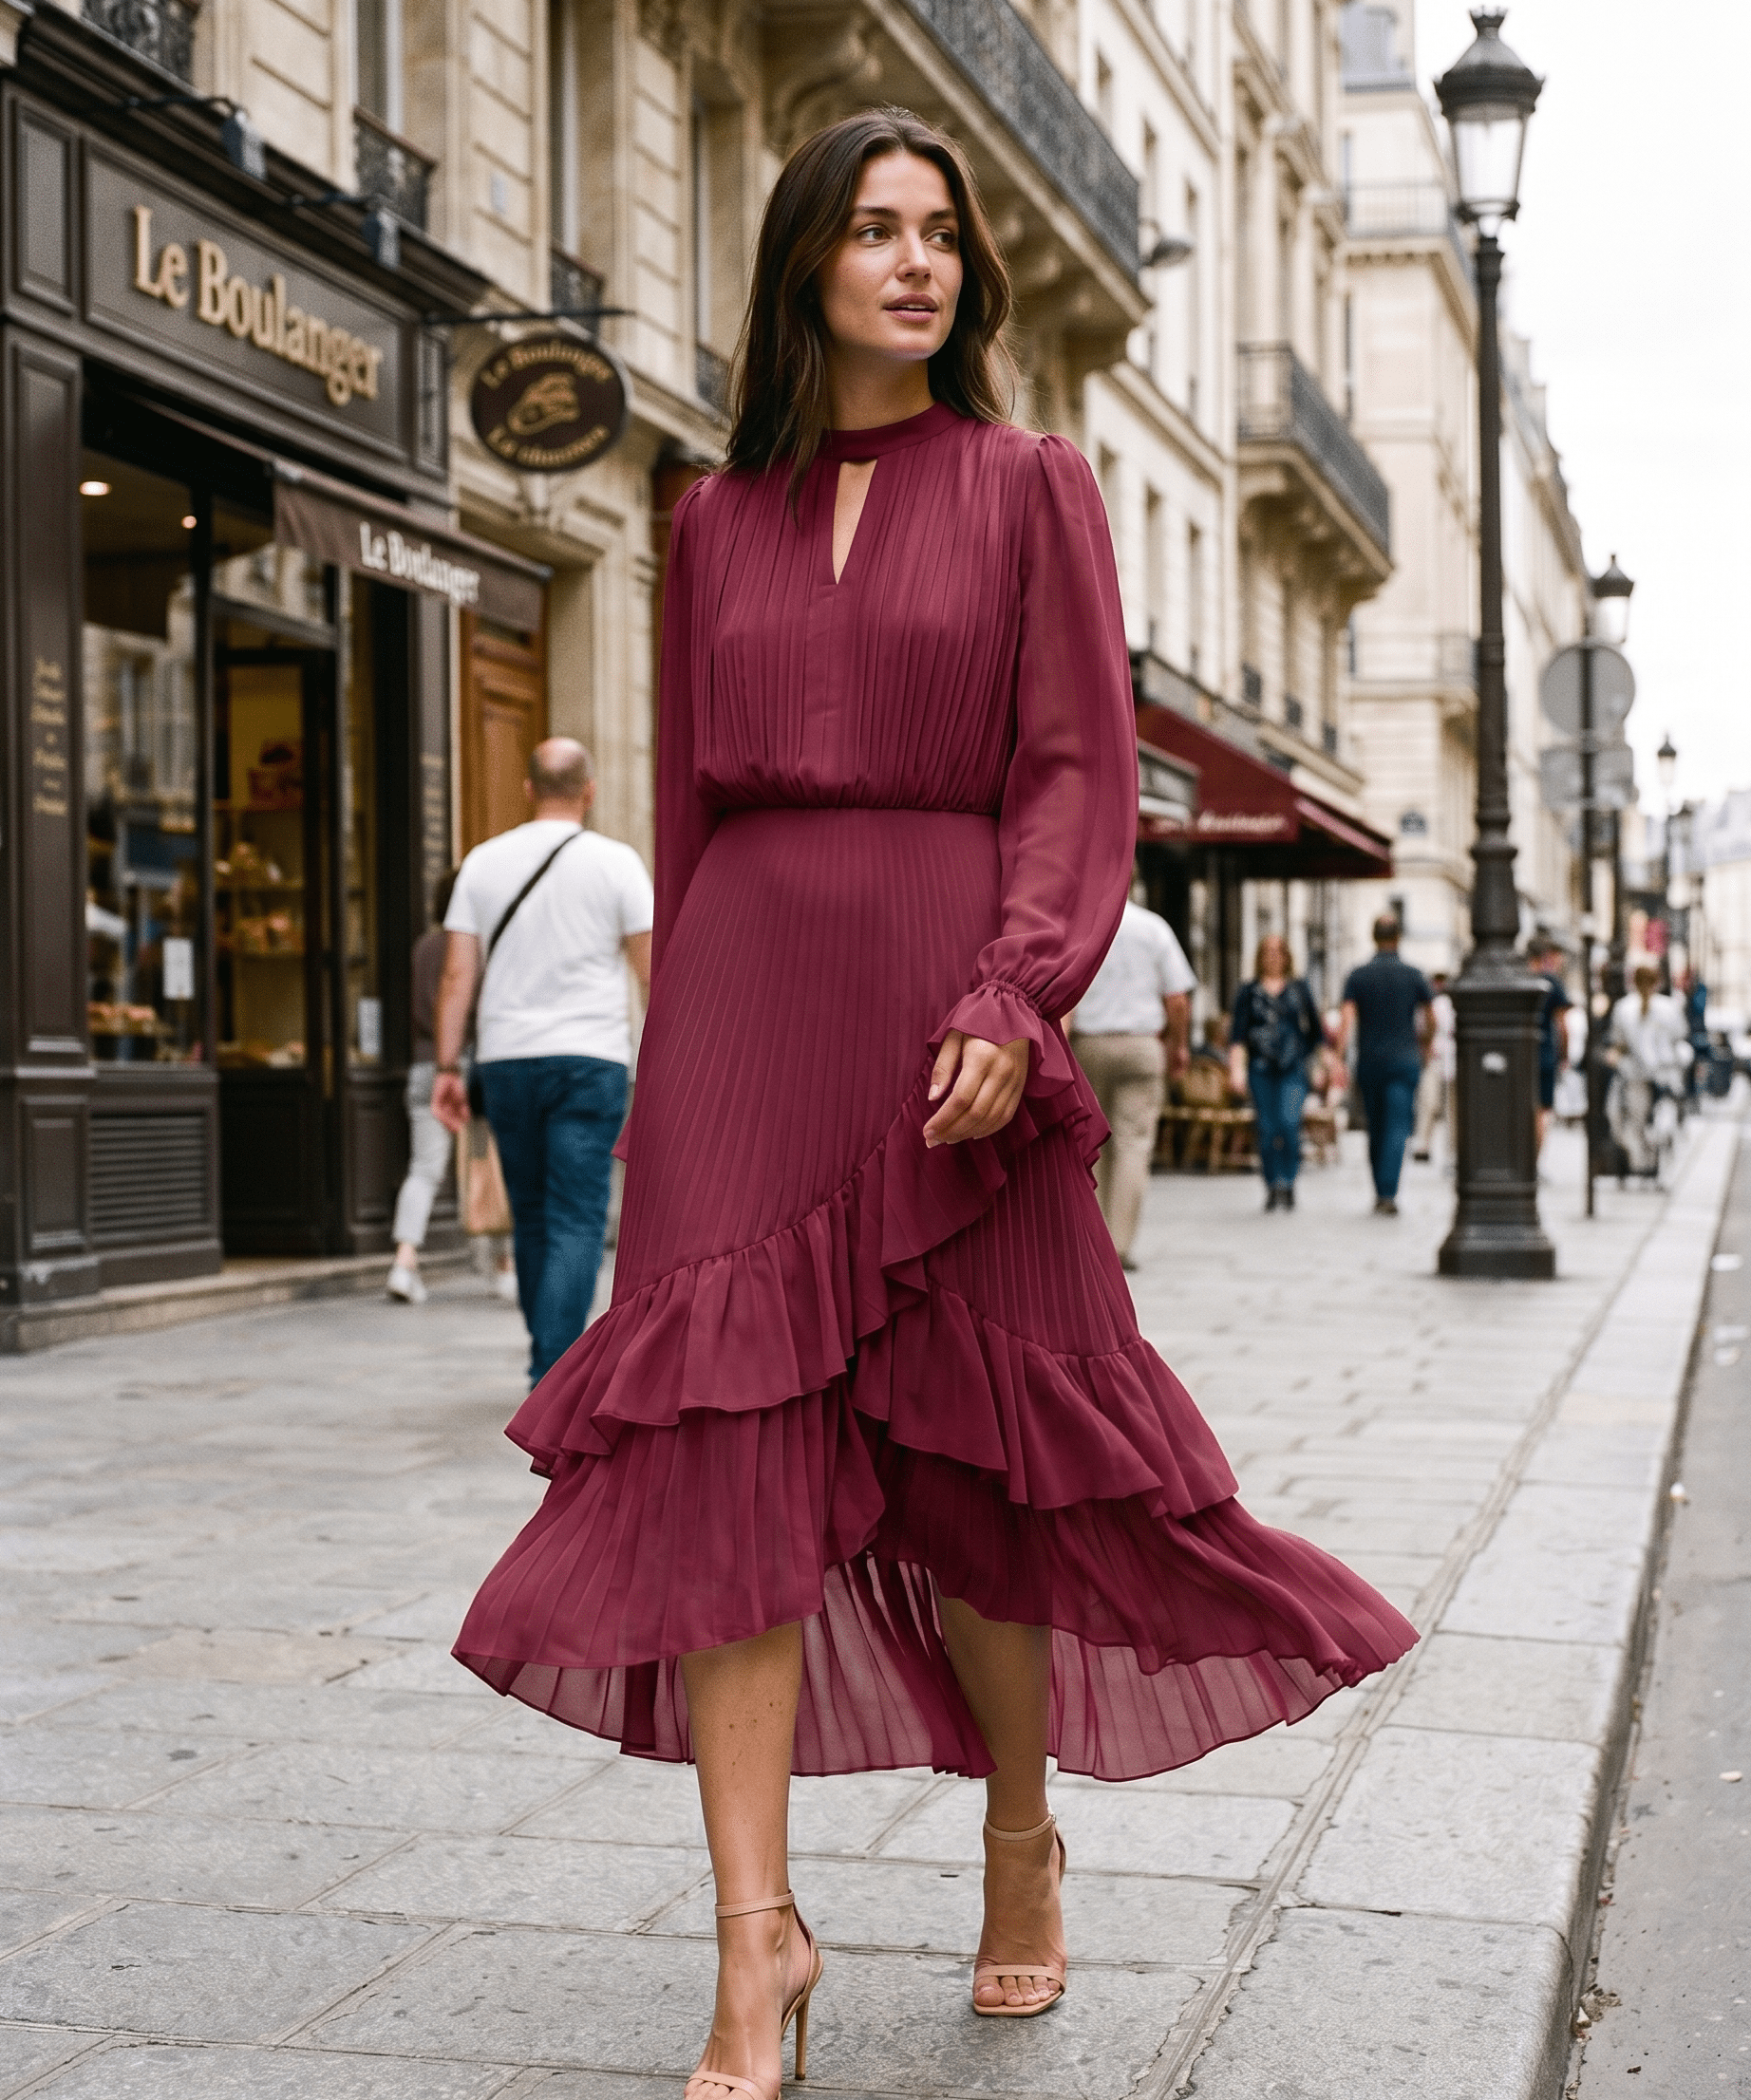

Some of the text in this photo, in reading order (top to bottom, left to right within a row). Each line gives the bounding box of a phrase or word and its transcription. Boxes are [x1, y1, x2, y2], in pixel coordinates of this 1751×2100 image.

[136, 205, 382, 405] Le Boulanger
[360, 521, 388, 572] Le
